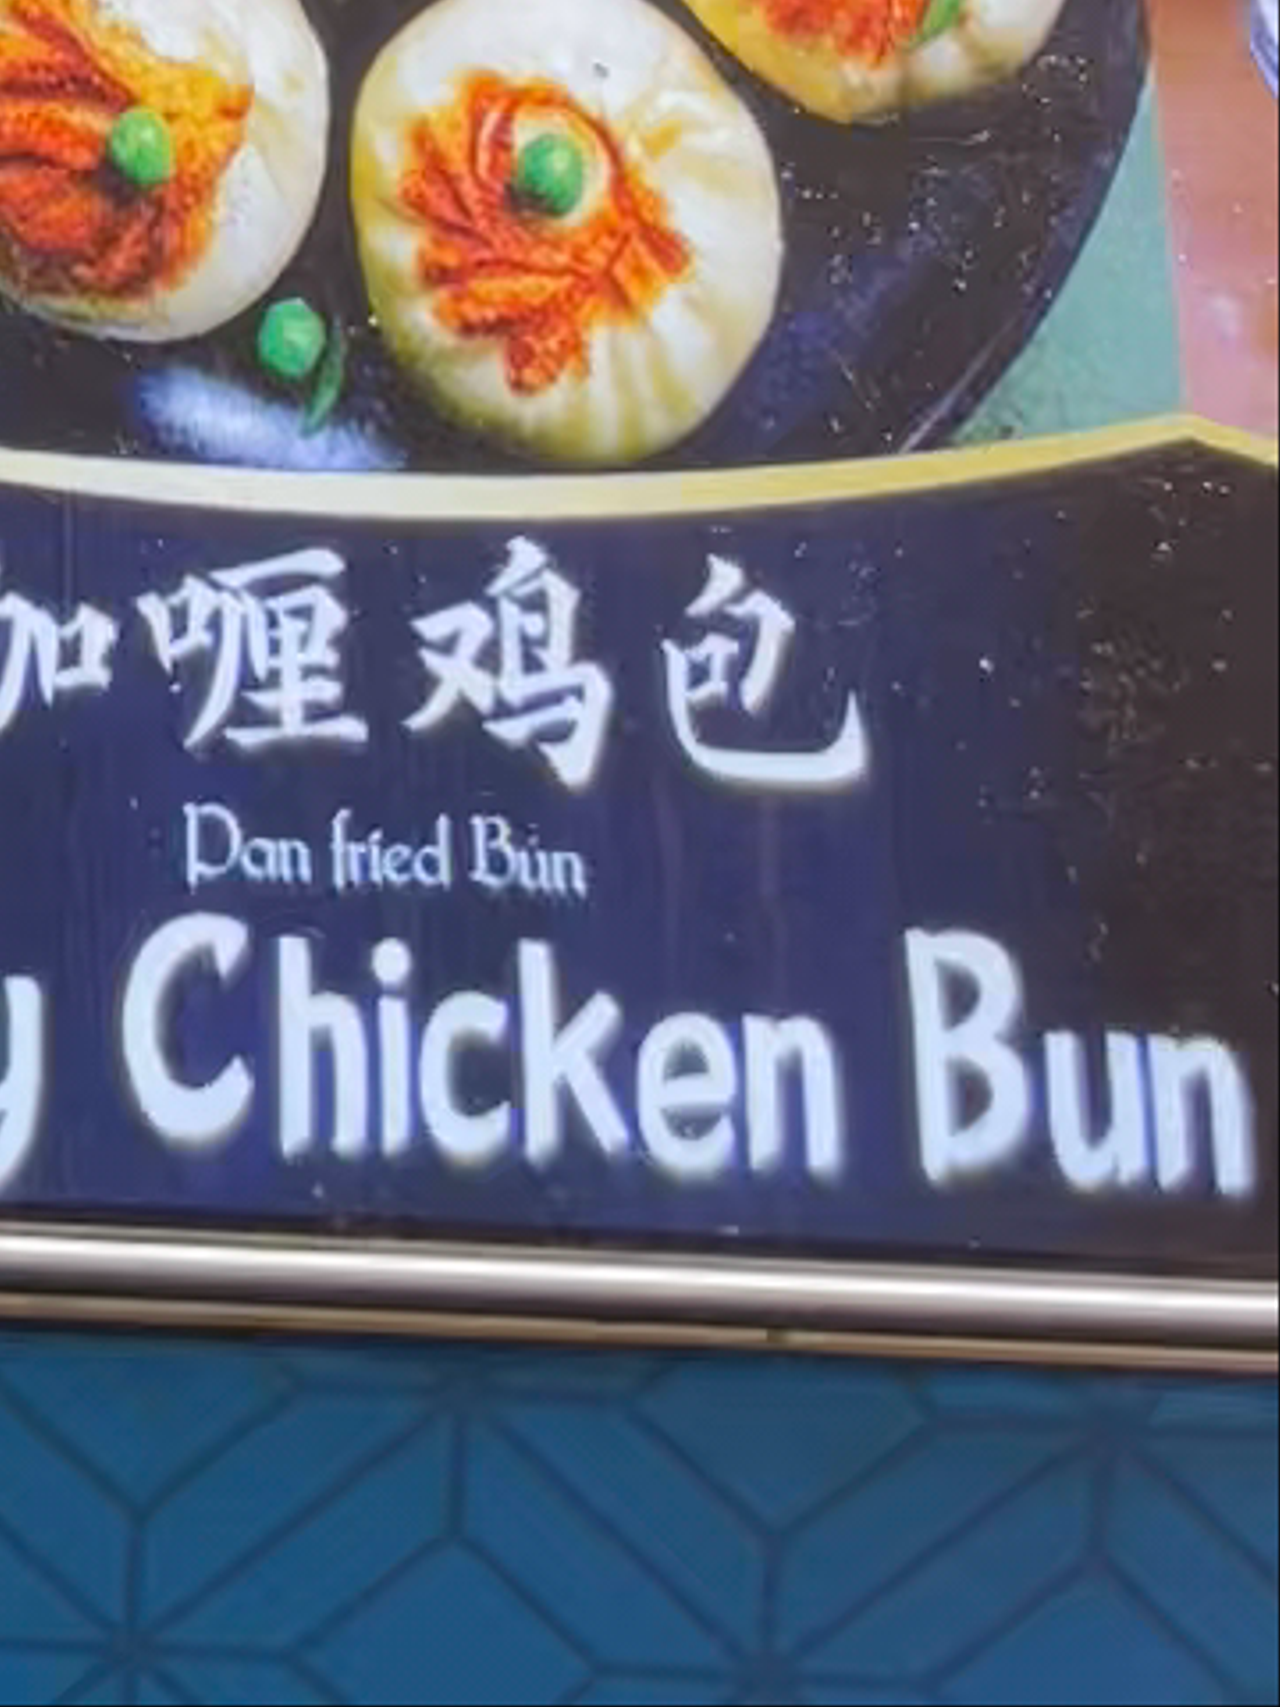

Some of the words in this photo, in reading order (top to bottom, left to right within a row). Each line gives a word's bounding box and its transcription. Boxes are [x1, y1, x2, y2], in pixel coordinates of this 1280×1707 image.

[182, 801, 313, 892] Pan
[329, 807, 453, 892] fried
[468, 814, 588, 898] Bun
[120, 910, 843, 1180] Chicken
[903, 927, 1254, 1196] Bun
